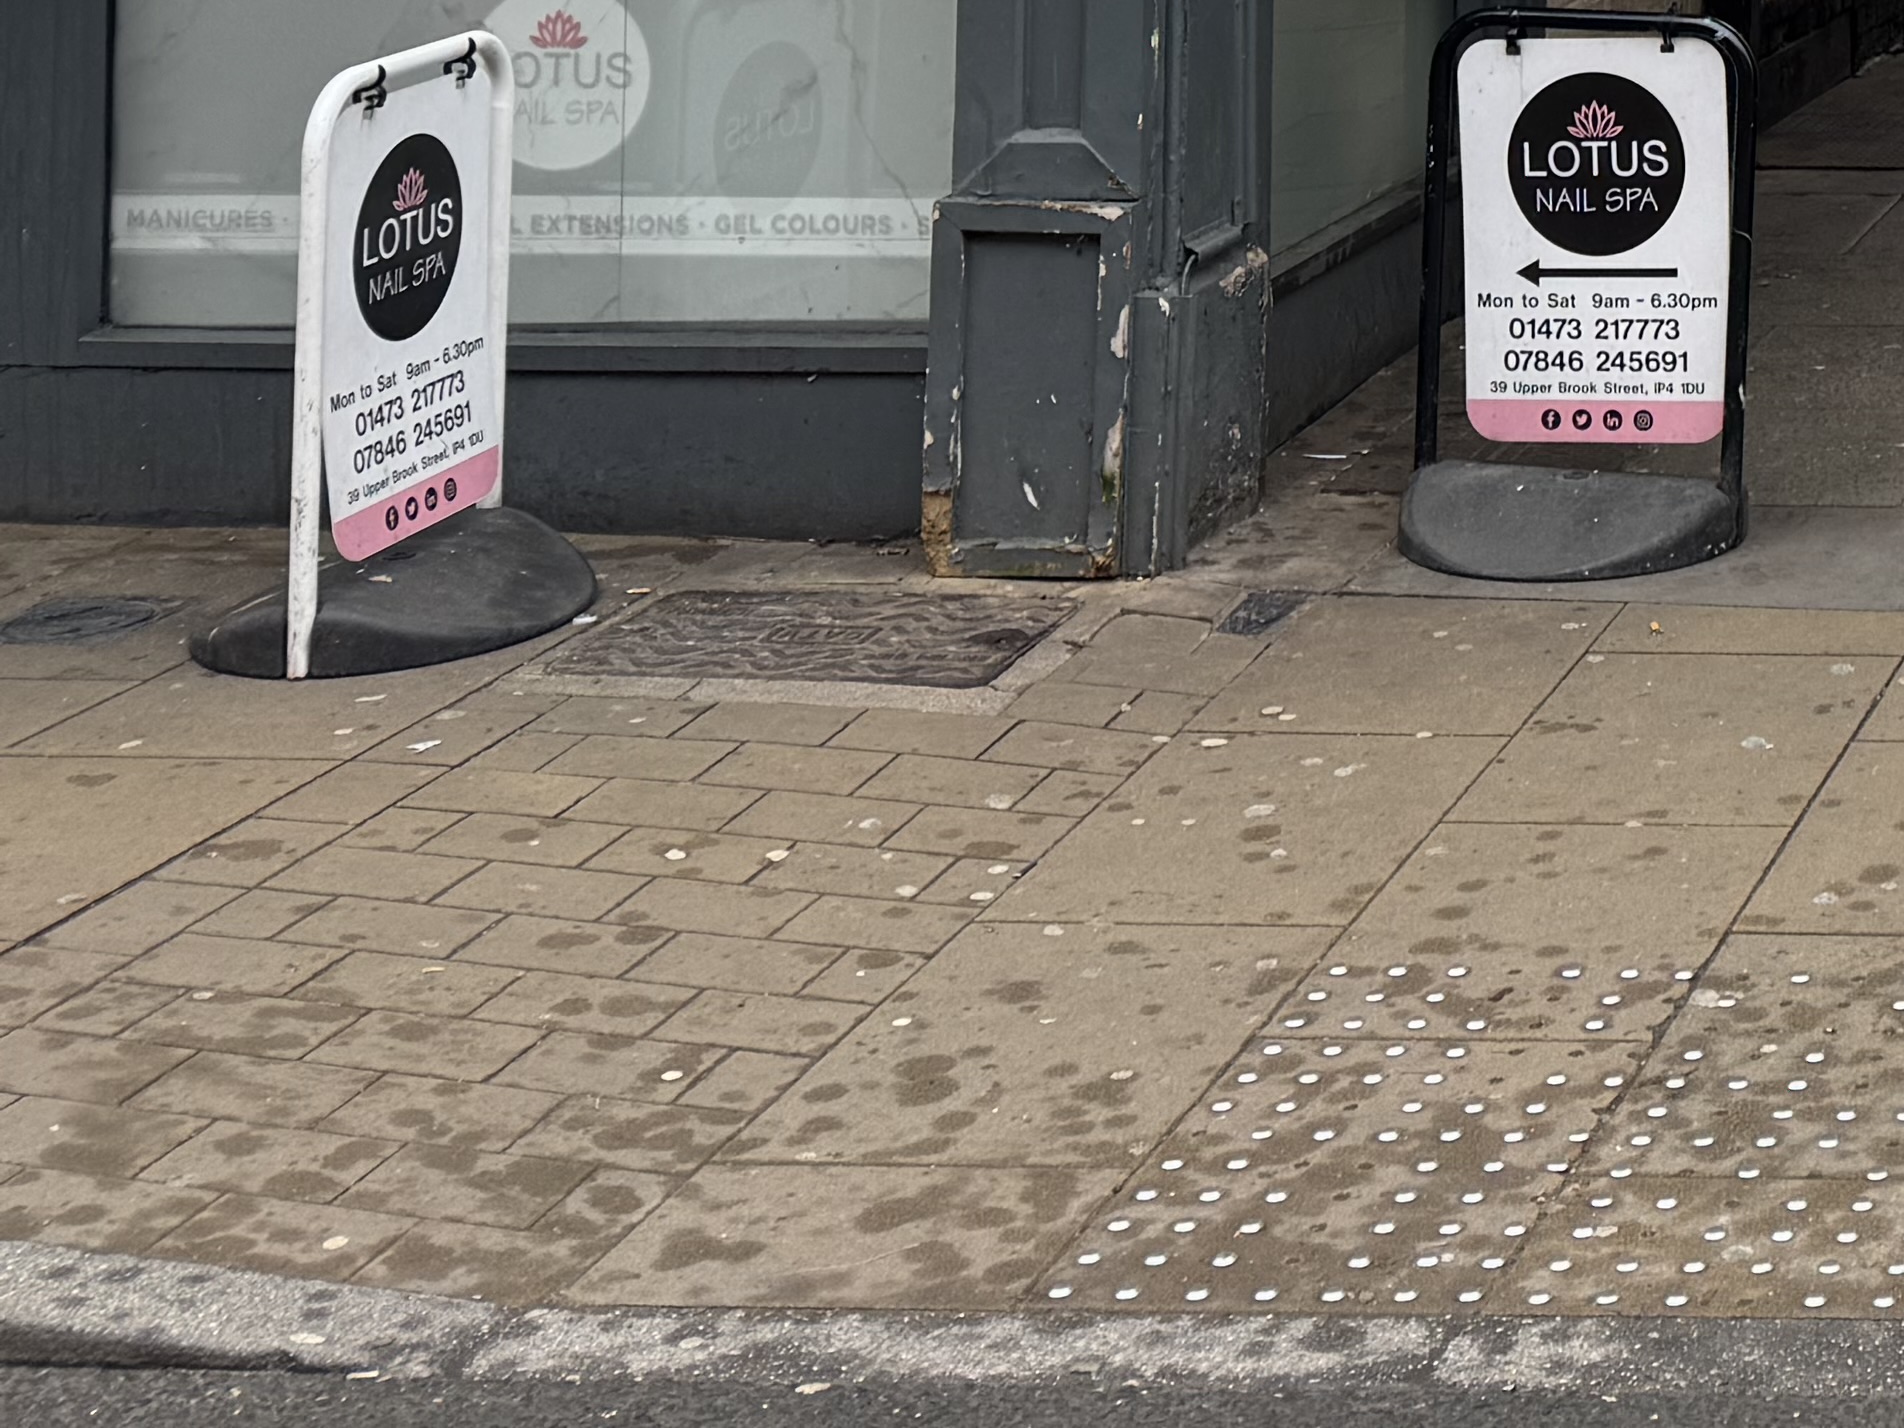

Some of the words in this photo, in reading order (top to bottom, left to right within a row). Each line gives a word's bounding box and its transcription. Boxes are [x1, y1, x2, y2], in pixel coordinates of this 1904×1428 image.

[1522, 139, 1669, 178] LOTUS
[1535, 187, 1597, 213] NAIL
[1604, 187, 1659, 213] SPA
[126, 208, 273, 229] MANICURES
[363, 197, 454, 268] LOTUS
[530, 213, 690, 237] EXTENSIONS
[714, 213, 763, 236] GEL
[770, 213, 894, 237] COLOURS
[368, 266, 409, 305] NAIL
[411, 250, 447, 288] SPA
[1477, 293, 1514, 309] Mon
[1522, 294, 1539, 309] to
[1547, 293, 1576, 309] Sat
[1591, 293, 1630, 309] 9am
[1650, 293, 1718, 312] 6.30pm
[1509, 317, 1582, 340] 01473
[1594, 317, 1680, 341] 217773
[1503, 349, 1584, 373] 07846
[1595, 350, 1688, 373] 245691
[329, 389, 356, 414] Mon
[359, 383, 373, 401] to
[376, 370, 397, 393] Sat
[405, 357, 432, 381] 9am
[1490, 381, 1508, 394] 39
[1513, 381, 1552, 396] Upper
[1558, 381, 1597, 394] Brook
[1654, 382, 1674, 394] IP4
[1681, 382, 1705, 394] 1DU
[354, 395, 405, 437] 01473
[410, 369, 466, 414] 217773
[353, 429, 407, 475] 07846
[412, 399, 472, 448] 245691
[347, 489, 360, 506] 39
[362, 477, 391, 499] Upper
[391, 461, 419, 484] Brook
